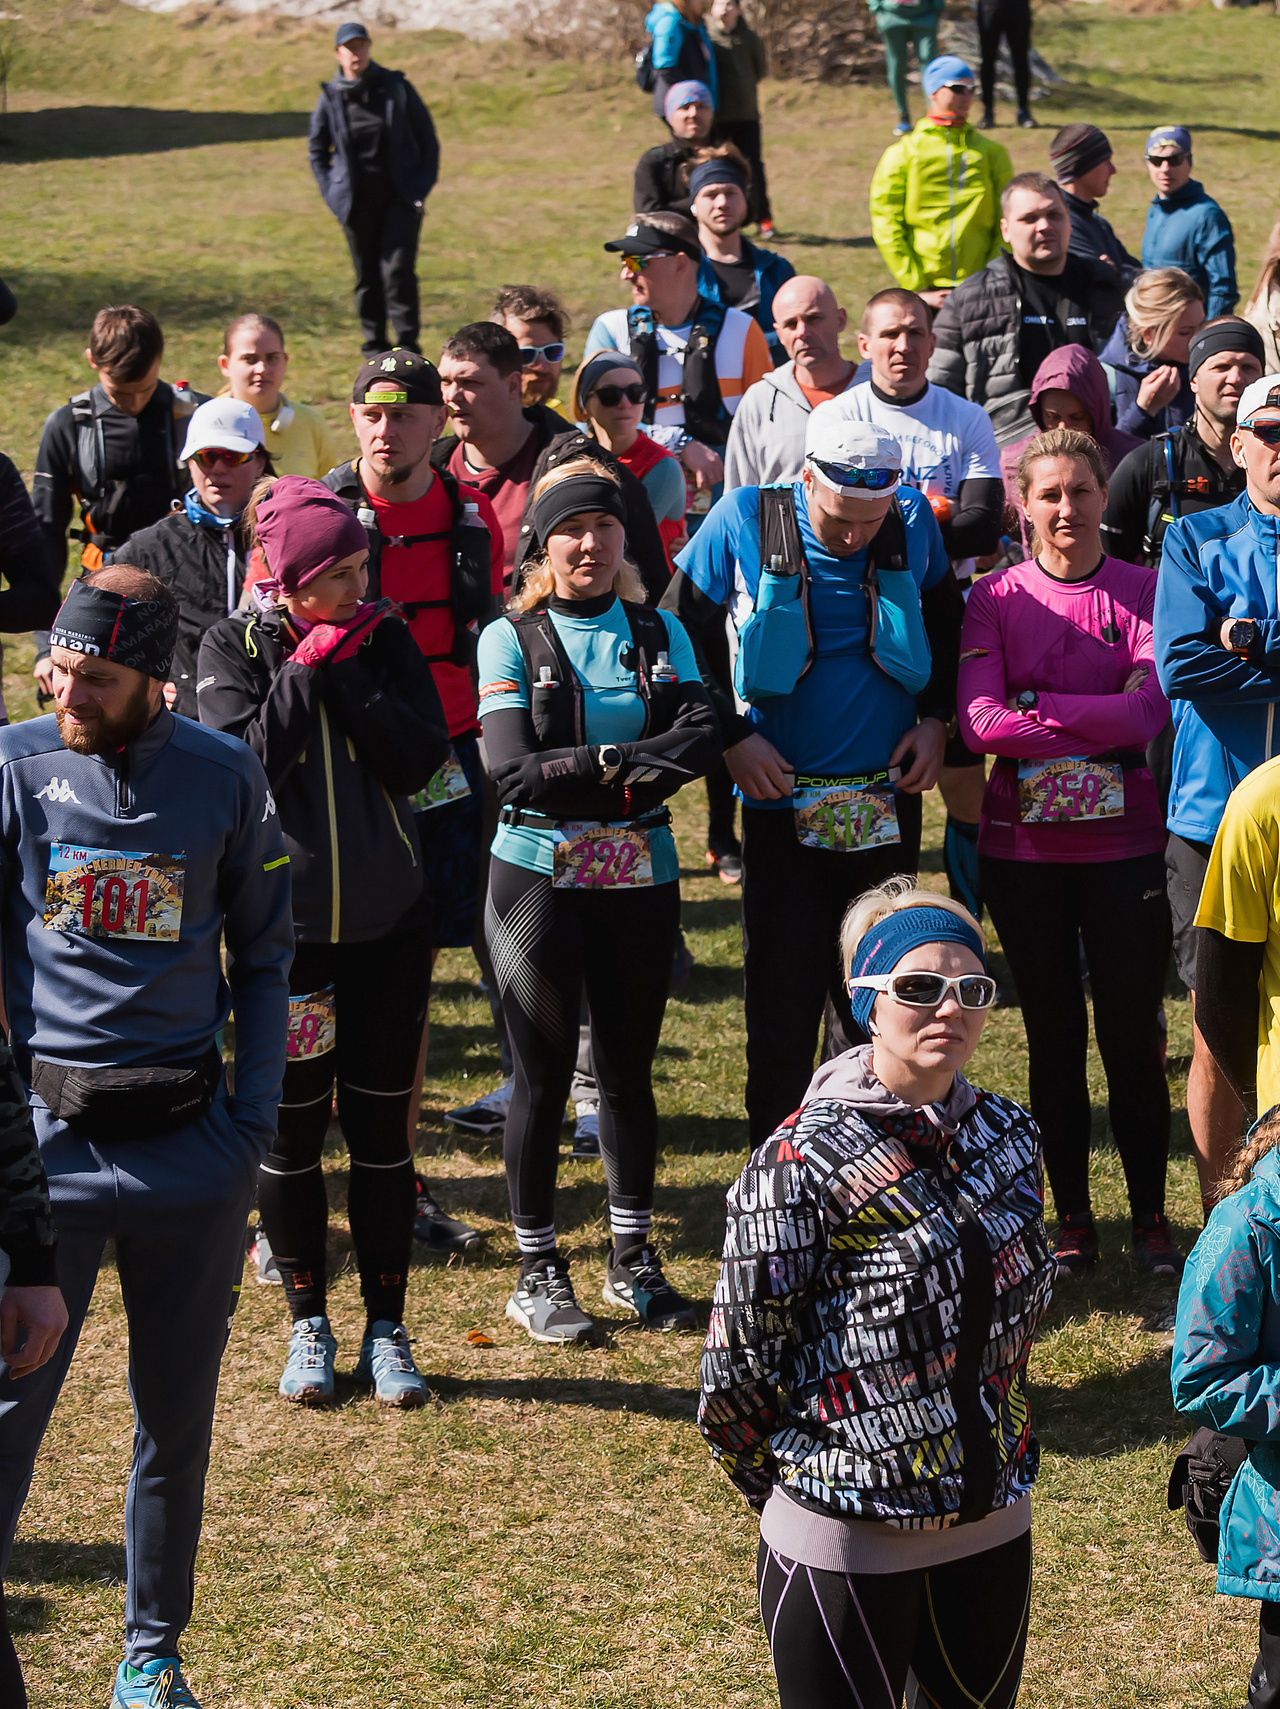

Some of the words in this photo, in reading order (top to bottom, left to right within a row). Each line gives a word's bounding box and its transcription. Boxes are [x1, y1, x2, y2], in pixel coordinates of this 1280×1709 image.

[796, 771, 888, 787] POWERUP
[1040, 774, 1100, 818] 259
[816, 804, 874, 847] 317
[58, 845, 71, 859] 12
[72, 850, 88, 861] KM
[575, 841, 634, 884] 222
[62, 858, 142, 885] ESKI-KERMEN
[143, 864, 174, 894] TRAIL
[77, 874, 149, 933] 101
[902, 1428, 965, 1482] RUN
